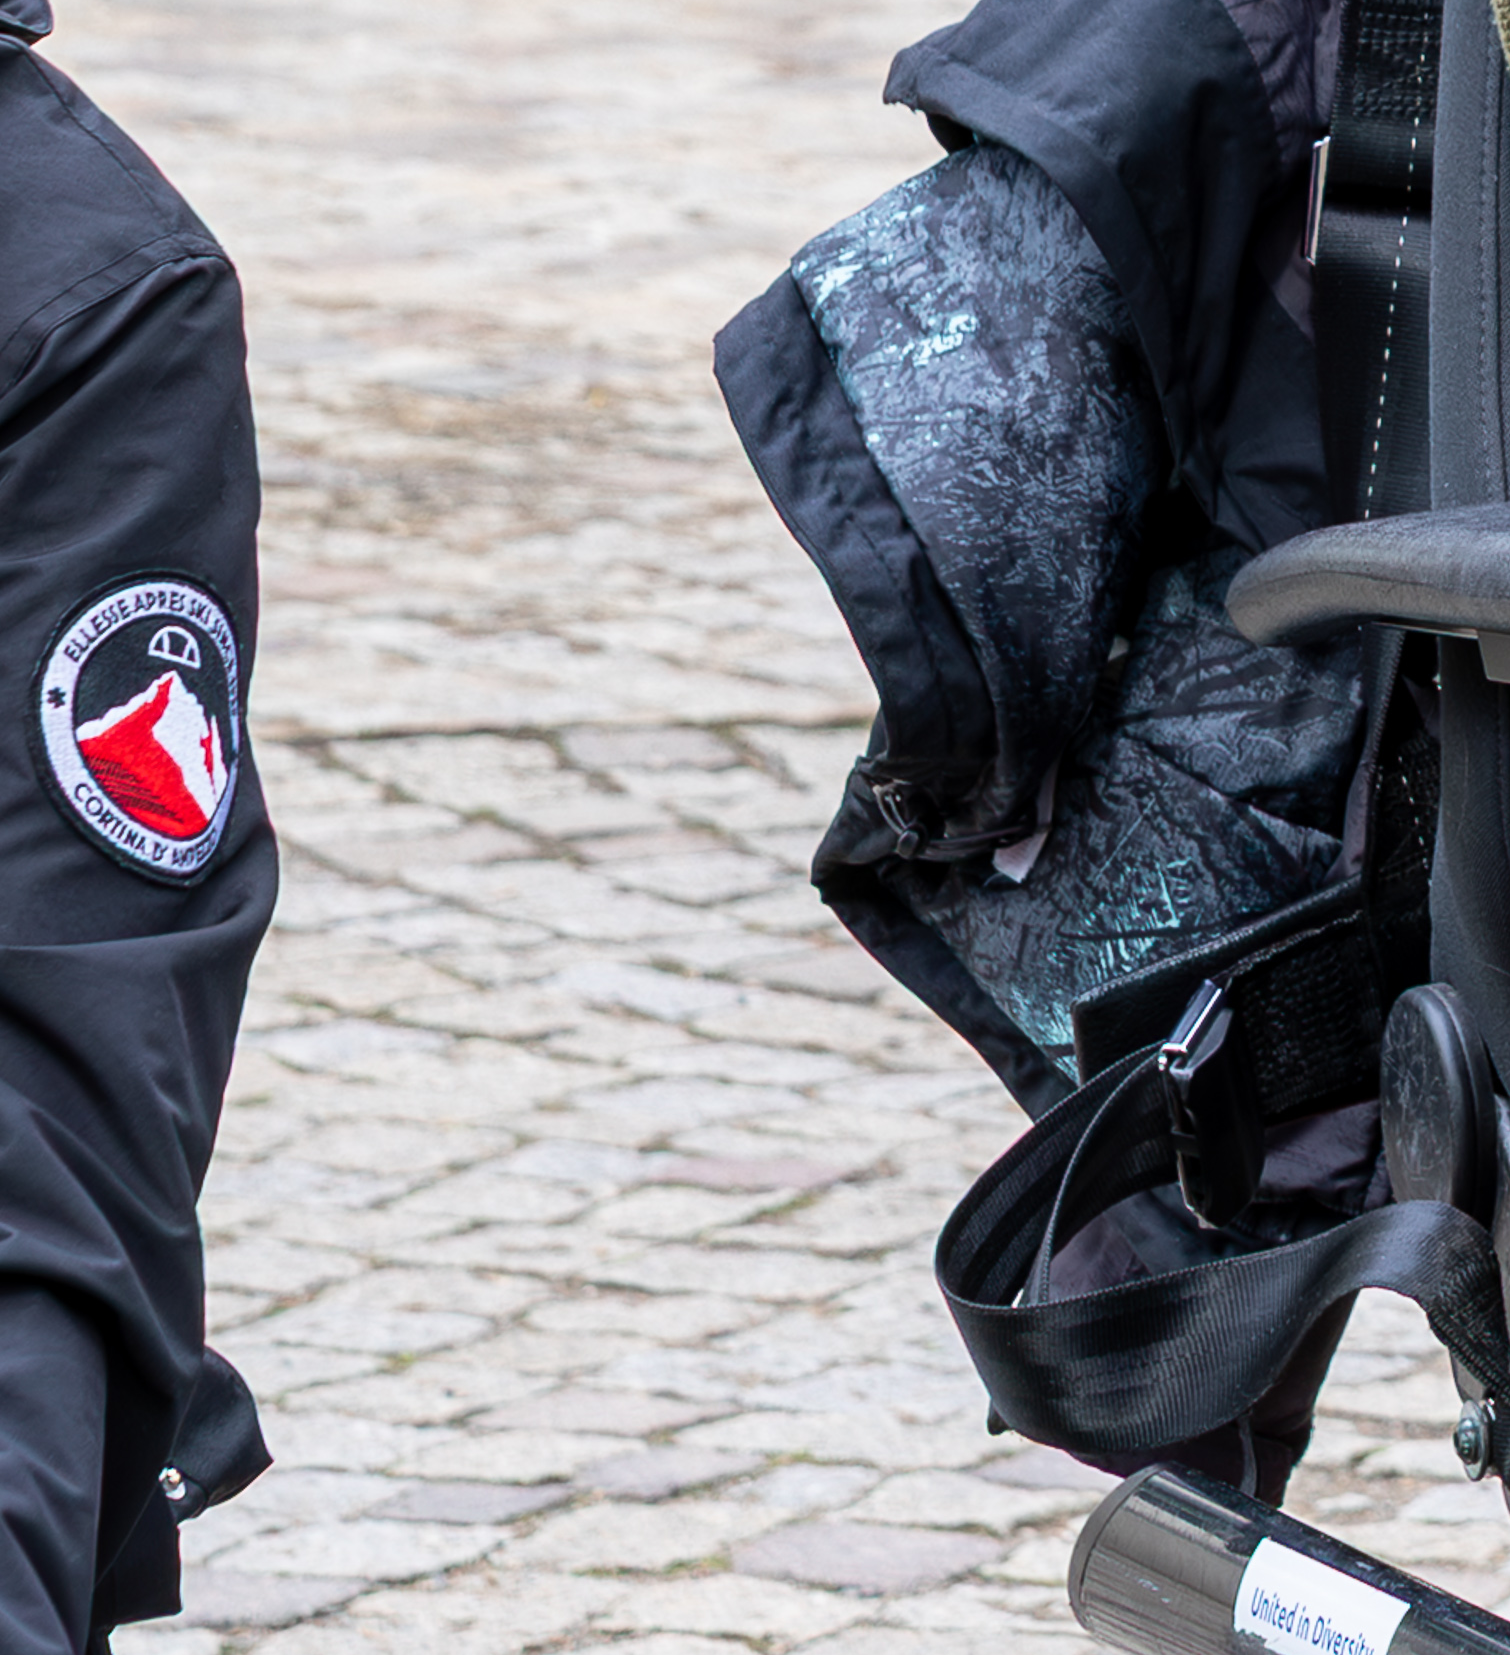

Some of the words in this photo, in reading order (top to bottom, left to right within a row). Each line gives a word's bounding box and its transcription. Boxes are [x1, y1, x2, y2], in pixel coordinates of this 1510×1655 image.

[63, 598, 131, 664] ELLESSE
[74, 782, 147, 856] CORTINA
[1250, 1586, 1300, 1634] United
[1295, 1605, 1311, 1641] in
